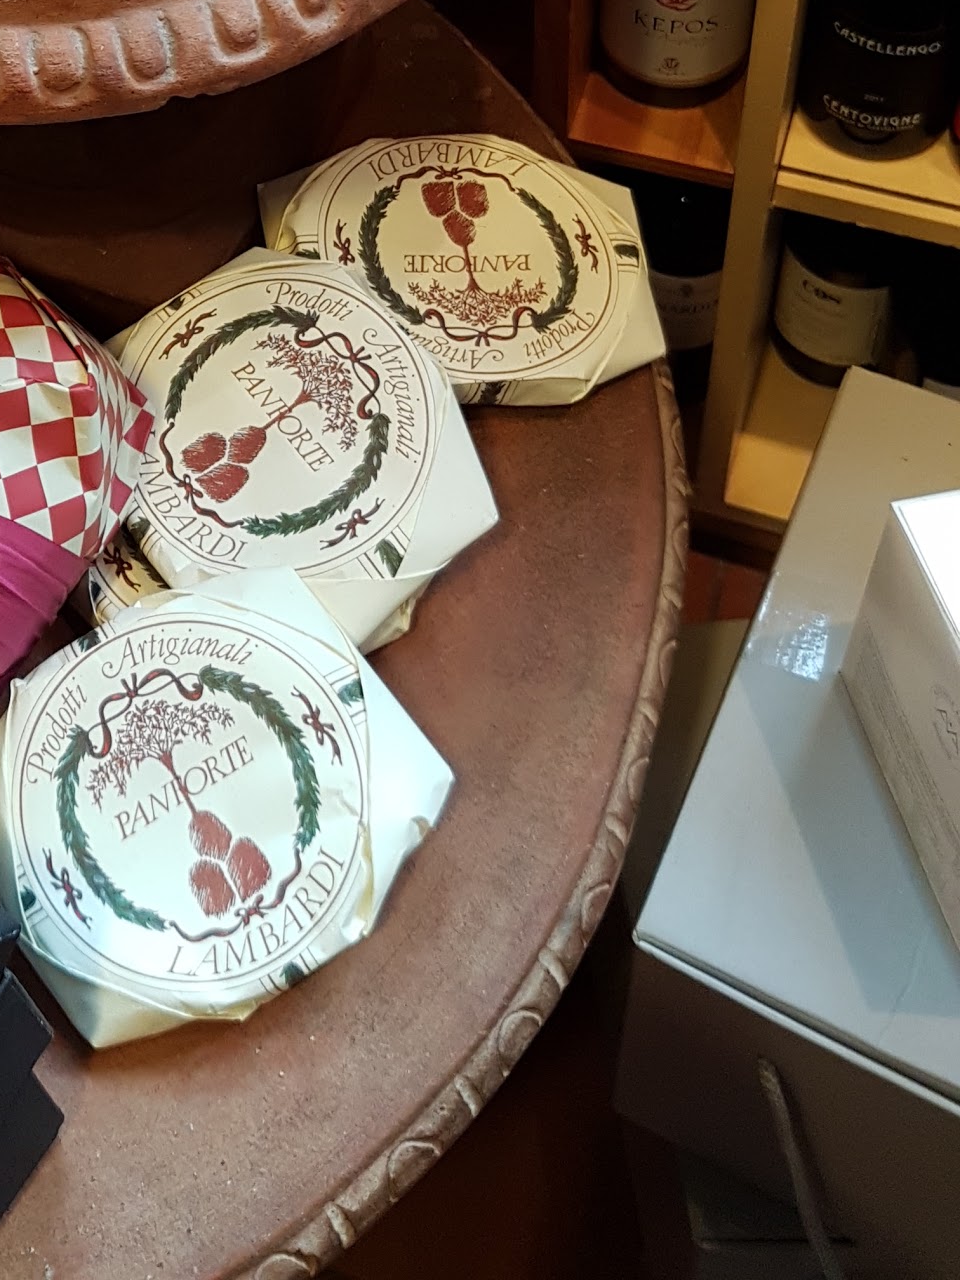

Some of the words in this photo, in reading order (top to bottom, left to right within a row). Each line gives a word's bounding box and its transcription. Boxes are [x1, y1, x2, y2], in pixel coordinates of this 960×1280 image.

[633, 8, 719, 34] KEPOS
[833, 21, 942, 56] CASTELLENGO
[822, 94, 922, 127] CENTOVIGNE
[365, 140, 534, 183] LAMBARDI
[402, 252, 533, 275] PANFORTE
[522, 309, 596, 362] Prodotti
[265, 281, 361, 324] Prodotti
[362, 327, 421, 465] Artigianali
[230, 359, 335, 473] PANFORTE
[25, 675, 91, 786] Prodotti
[101, 627, 260, 680] Artigianali
[113, 736, 255, 842] PANFORTE
[166, 848, 345, 976] LAMBARDI
